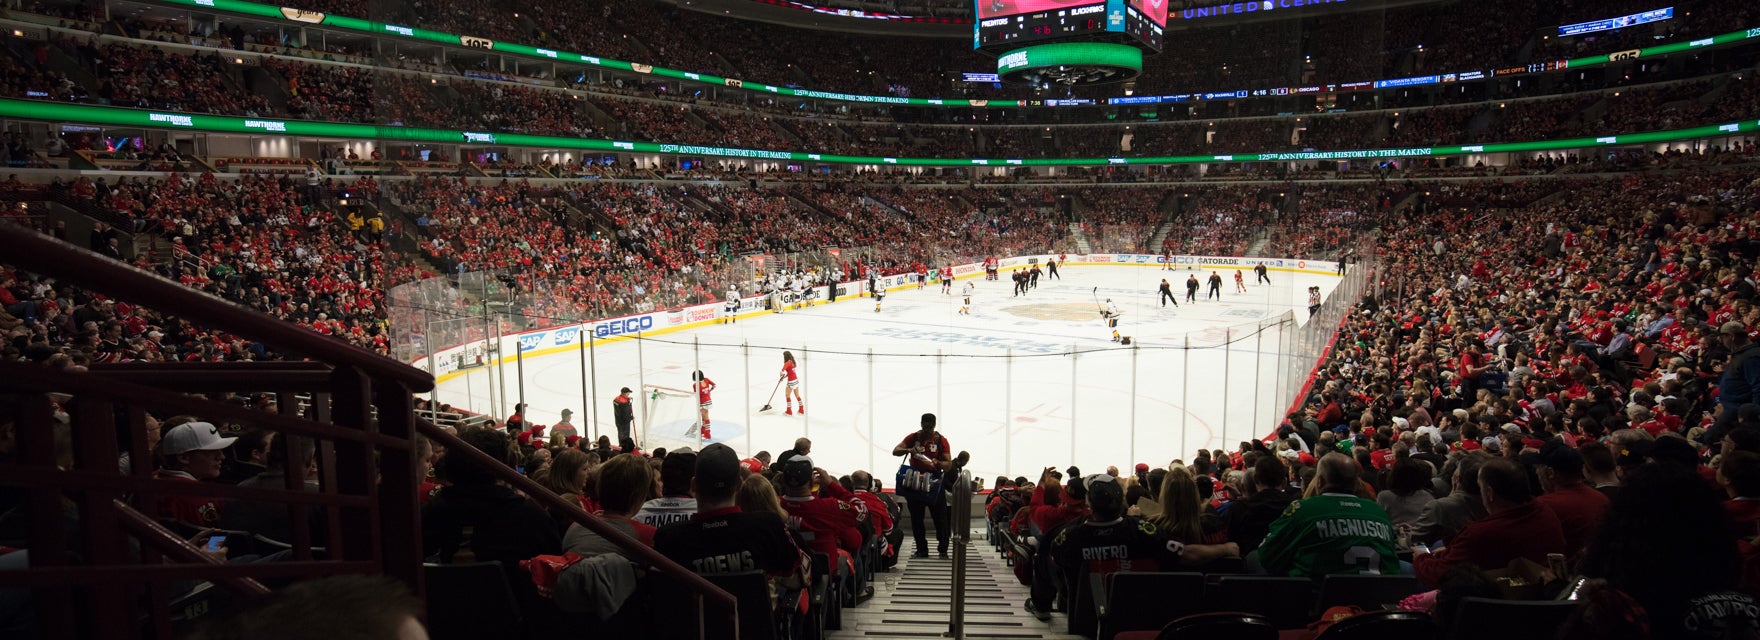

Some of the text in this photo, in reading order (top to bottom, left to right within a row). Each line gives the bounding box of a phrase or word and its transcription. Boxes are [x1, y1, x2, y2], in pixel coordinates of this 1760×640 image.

[1071, 5, 1105, 16] BLACKHAWKS
[1183, 4, 1258, 19] UNITED
[981, 18, 1008, 27] PREDATORS
[150, 114, 192, 124] HAWTHORNE
[245, 120, 285, 129] HAWTHORNE
[660, 144, 679, 152] 125TH
[678, 145, 725, 156] ANNIVERSARY:
[725, 149, 749, 157] HISTORY
[1278, 151, 1334, 160] ANNIVERSARY:
[1398, 148, 1431, 156] MAKING
[596, 316, 653, 338] GEICO
[520, 335, 541, 348] SAP
[555, 331, 576, 343] SAP
[1316, 518, 1391, 541] MAGNUSON
[1082, 545, 1128, 560] RIVERO
[694, 550, 755, 576] TOEWS
